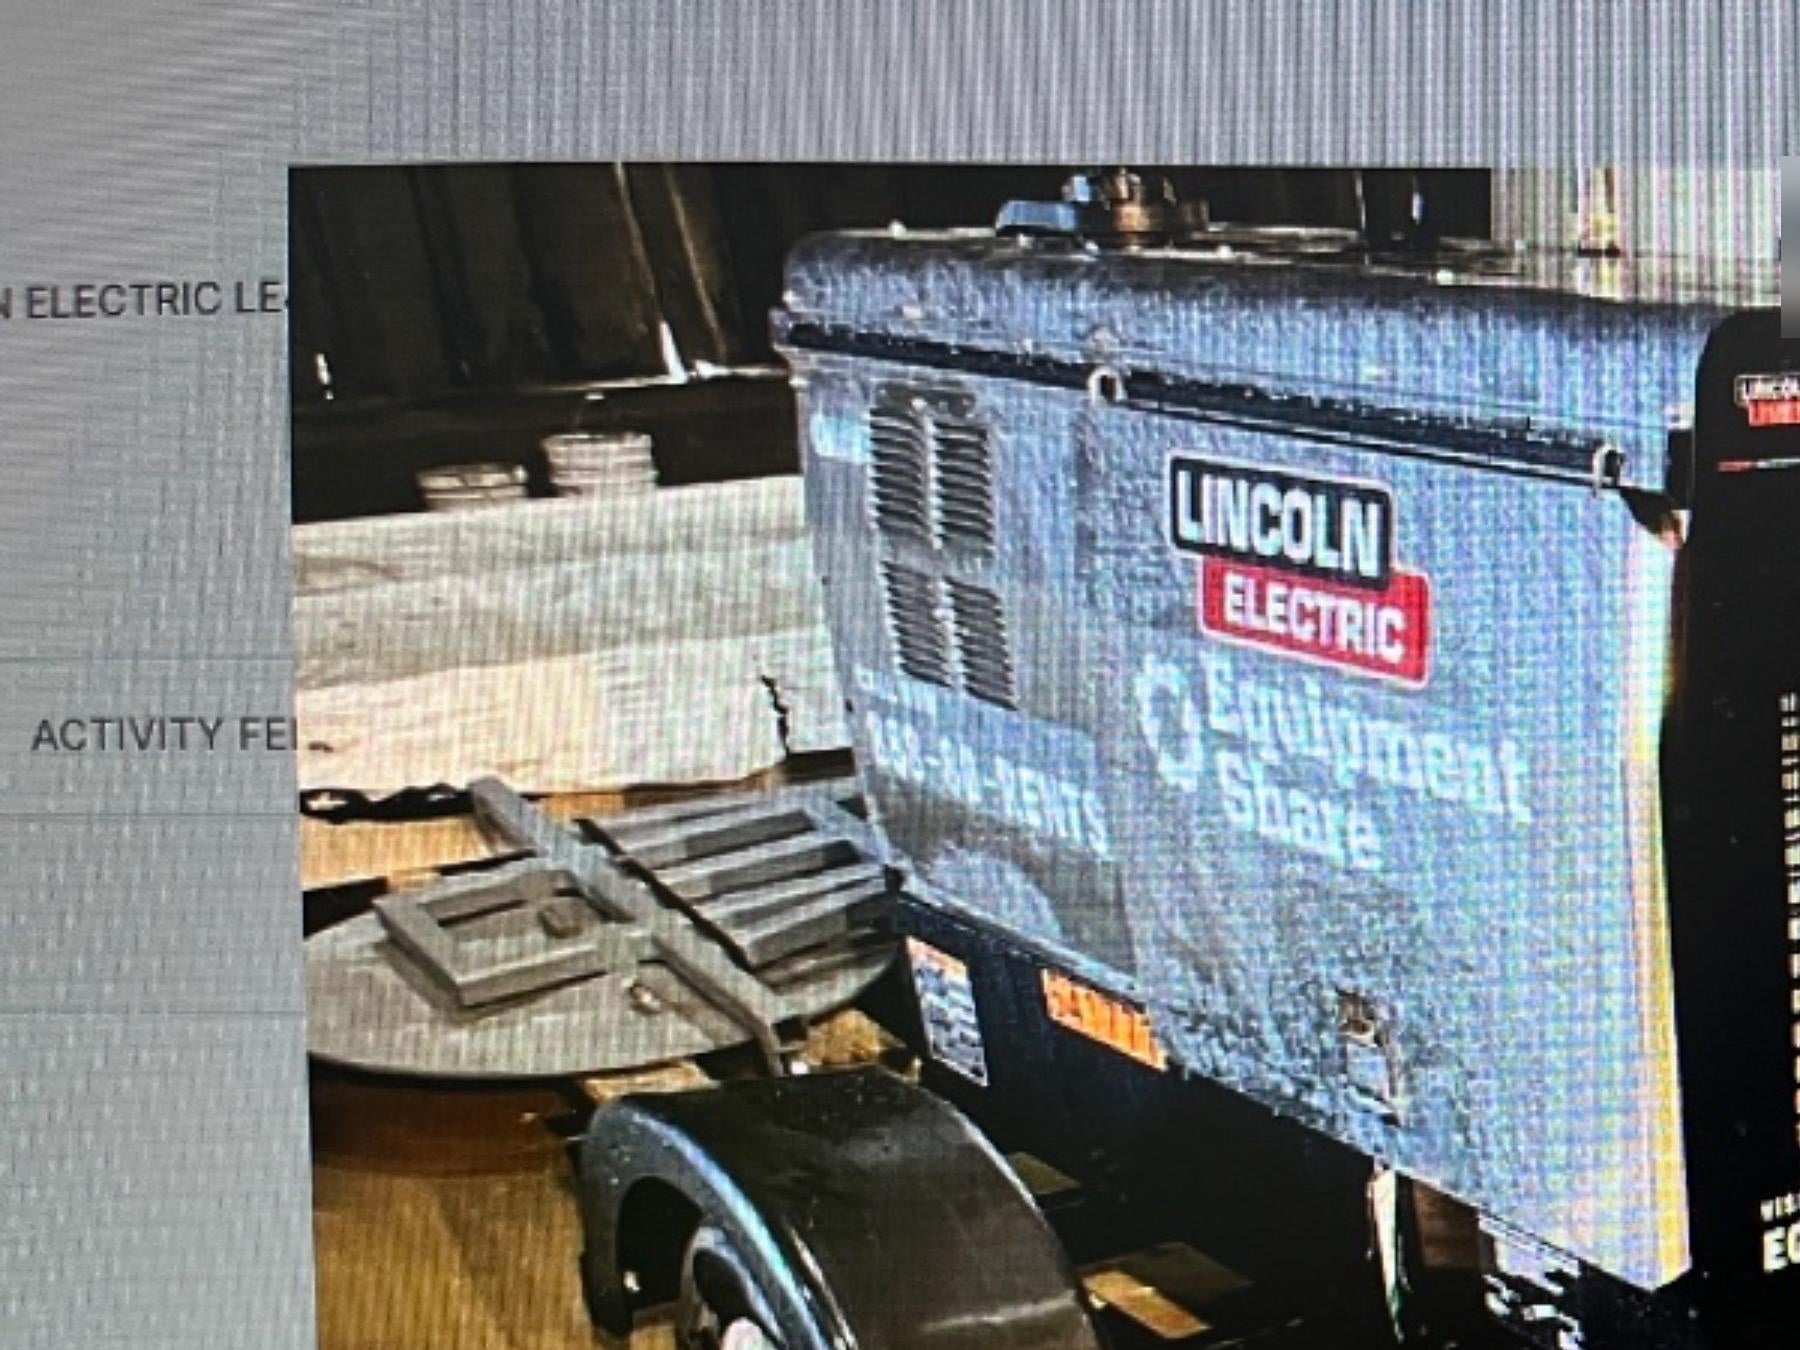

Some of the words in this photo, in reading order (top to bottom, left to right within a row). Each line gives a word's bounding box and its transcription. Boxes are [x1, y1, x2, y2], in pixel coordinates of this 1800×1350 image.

[26, 281, 223, 319] ELECTRIC
[234, 281, 289, 314] LE
[1176, 468, 1384, 578] LINCOLN
[1224, 571, 1407, 664] ELECTRIC
[30, 716, 223, 751] ACTIVITY
[239, 715, 298, 751] FE
[1203, 650, 1533, 826] Equipment
[1216, 750, 1383, 872] Share
